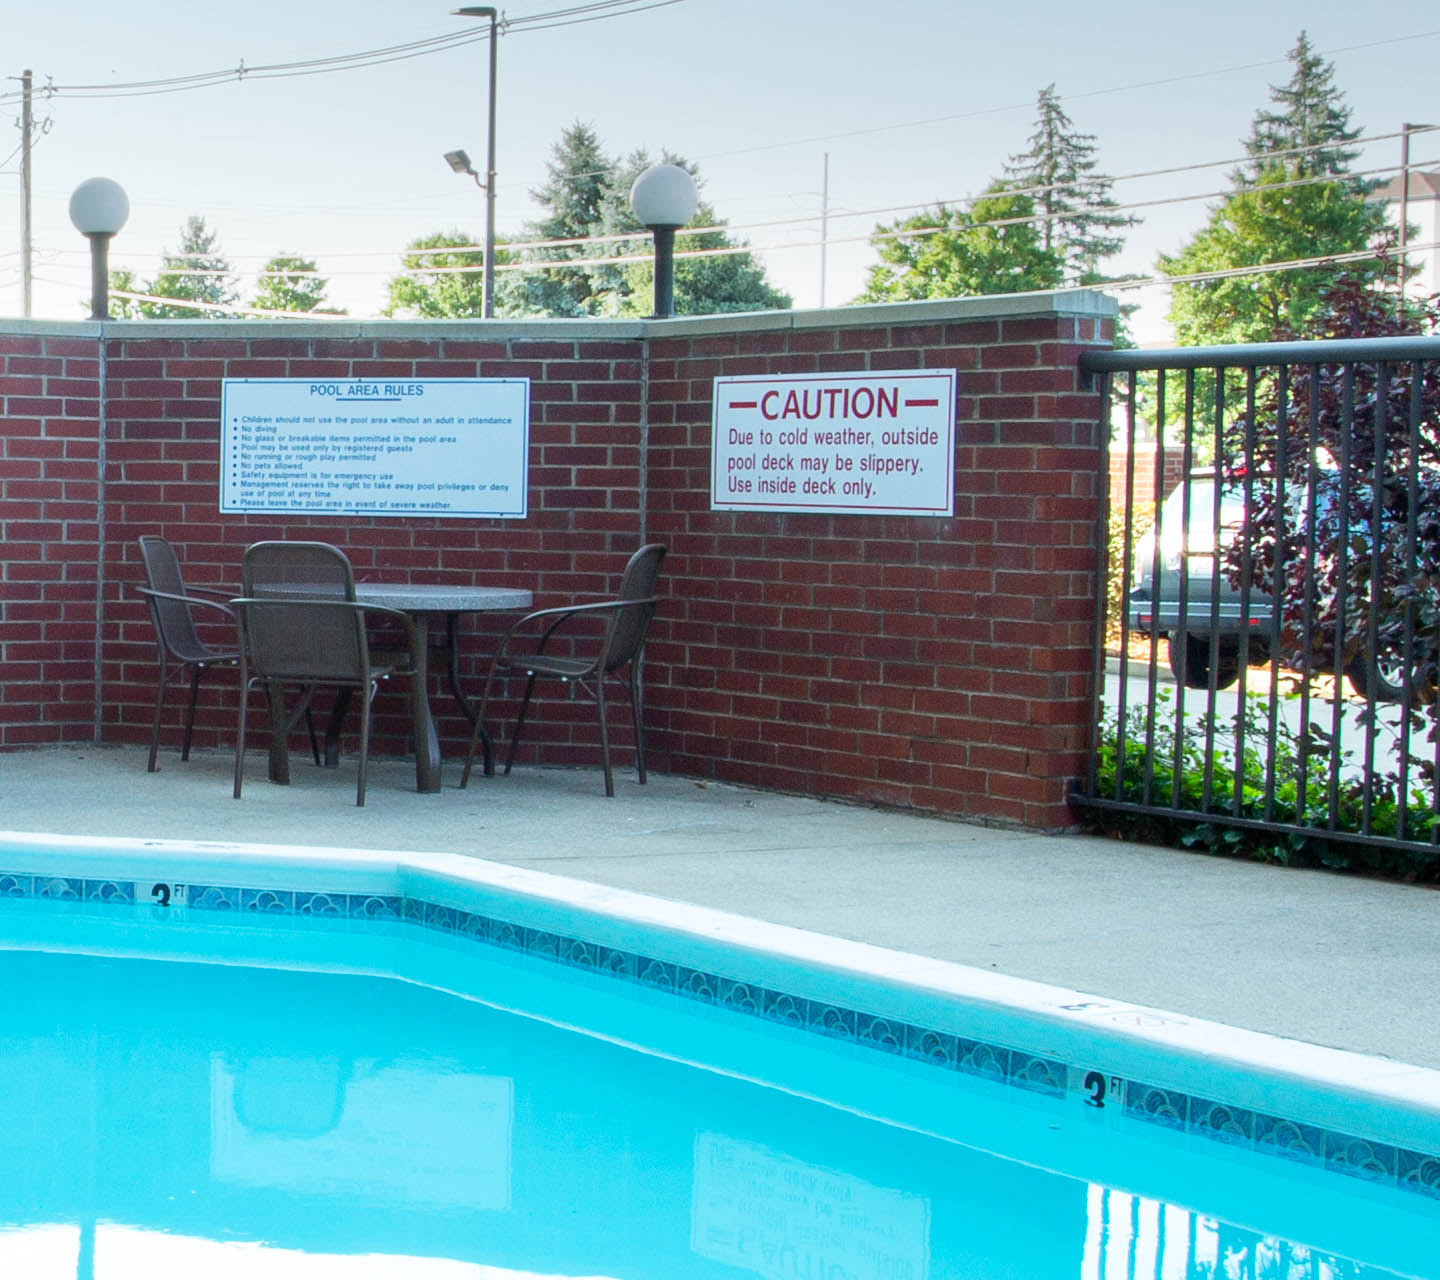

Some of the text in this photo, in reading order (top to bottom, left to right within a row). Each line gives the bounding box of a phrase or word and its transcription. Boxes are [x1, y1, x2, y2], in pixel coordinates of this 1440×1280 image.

[310, 385, 424, 396] POOL AREA RULES
[761, 388, 899, 421] CAUTION
[255, 426, 277, 434] diving
[255, 435, 275, 443] glass
[353, 435, 391, 443] permitted
[729, 427, 938, 448] Due to cold weather, outside
[241, 443, 258, 451] Pool
[331, 445, 341, 453] by
[344, 445, 384, 453] registered
[386, 445, 413, 454] guests
[254, 454, 282, 462] running
[296, 454, 317, 462] rough
[320, 454, 336, 462] play
[254, 463, 271, 471] pets
[728, 453, 924, 475] pool deck may be slippery.
[241, 471, 265, 480] Safety
[241, 481, 288, 489] Management
[342, 482, 360, 490] right
[437, 483, 476, 491] privileges
[490, 484, 509, 492] deny
[728, 476, 877, 499] Use inside deck only.
[151, 883, 185, 906] 3 FT
[1084, 1071, 1123, 1107] 3 FT
